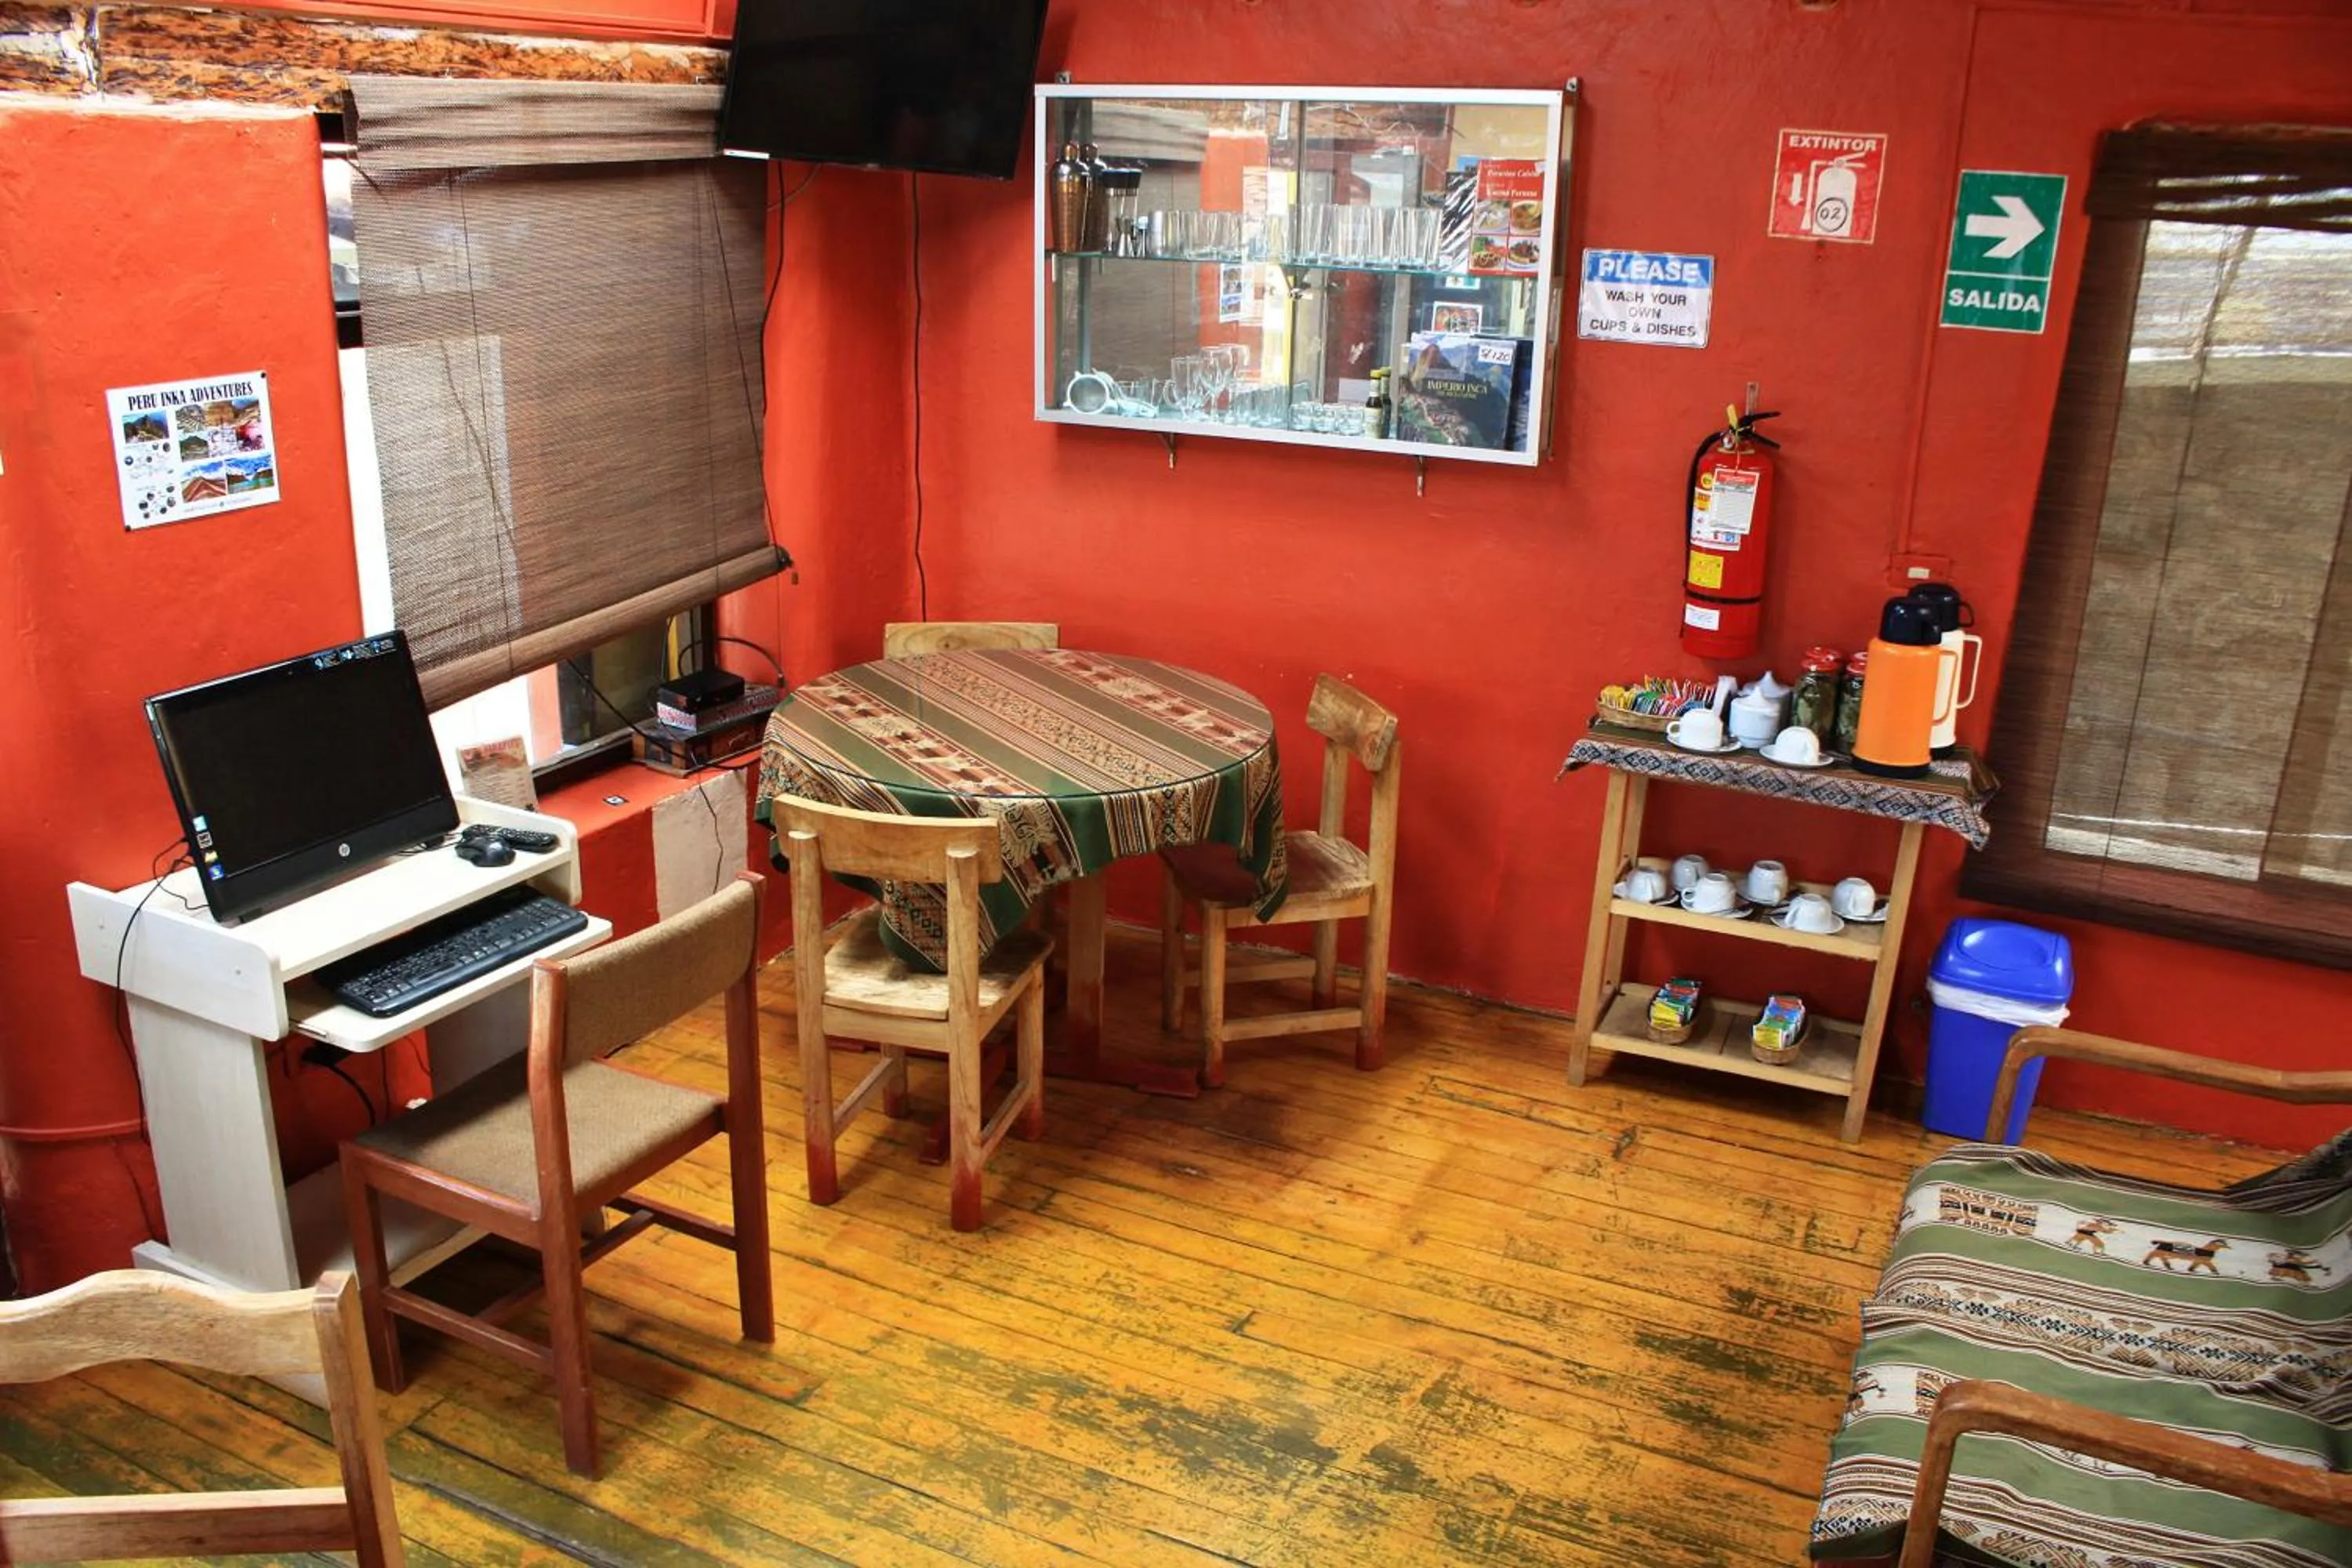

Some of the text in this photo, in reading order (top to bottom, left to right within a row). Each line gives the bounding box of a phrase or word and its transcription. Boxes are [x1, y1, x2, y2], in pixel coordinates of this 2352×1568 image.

[1789, 135, 1877, 151] EXTINTOR
[1820, 207, 1842, 220] 02
[1599, 257, 1700, 283] PLEASE
[1605, 289, 1687, 307] WASH YOUR
[1947, 288, 2042, 313] SALIDA
[1628, 307, 1662, 320] OWN
[1589, 318, 1697, 338] CUPS & DISHES
[128, 381, 253, 411] PERU INKA ADVENTURES
